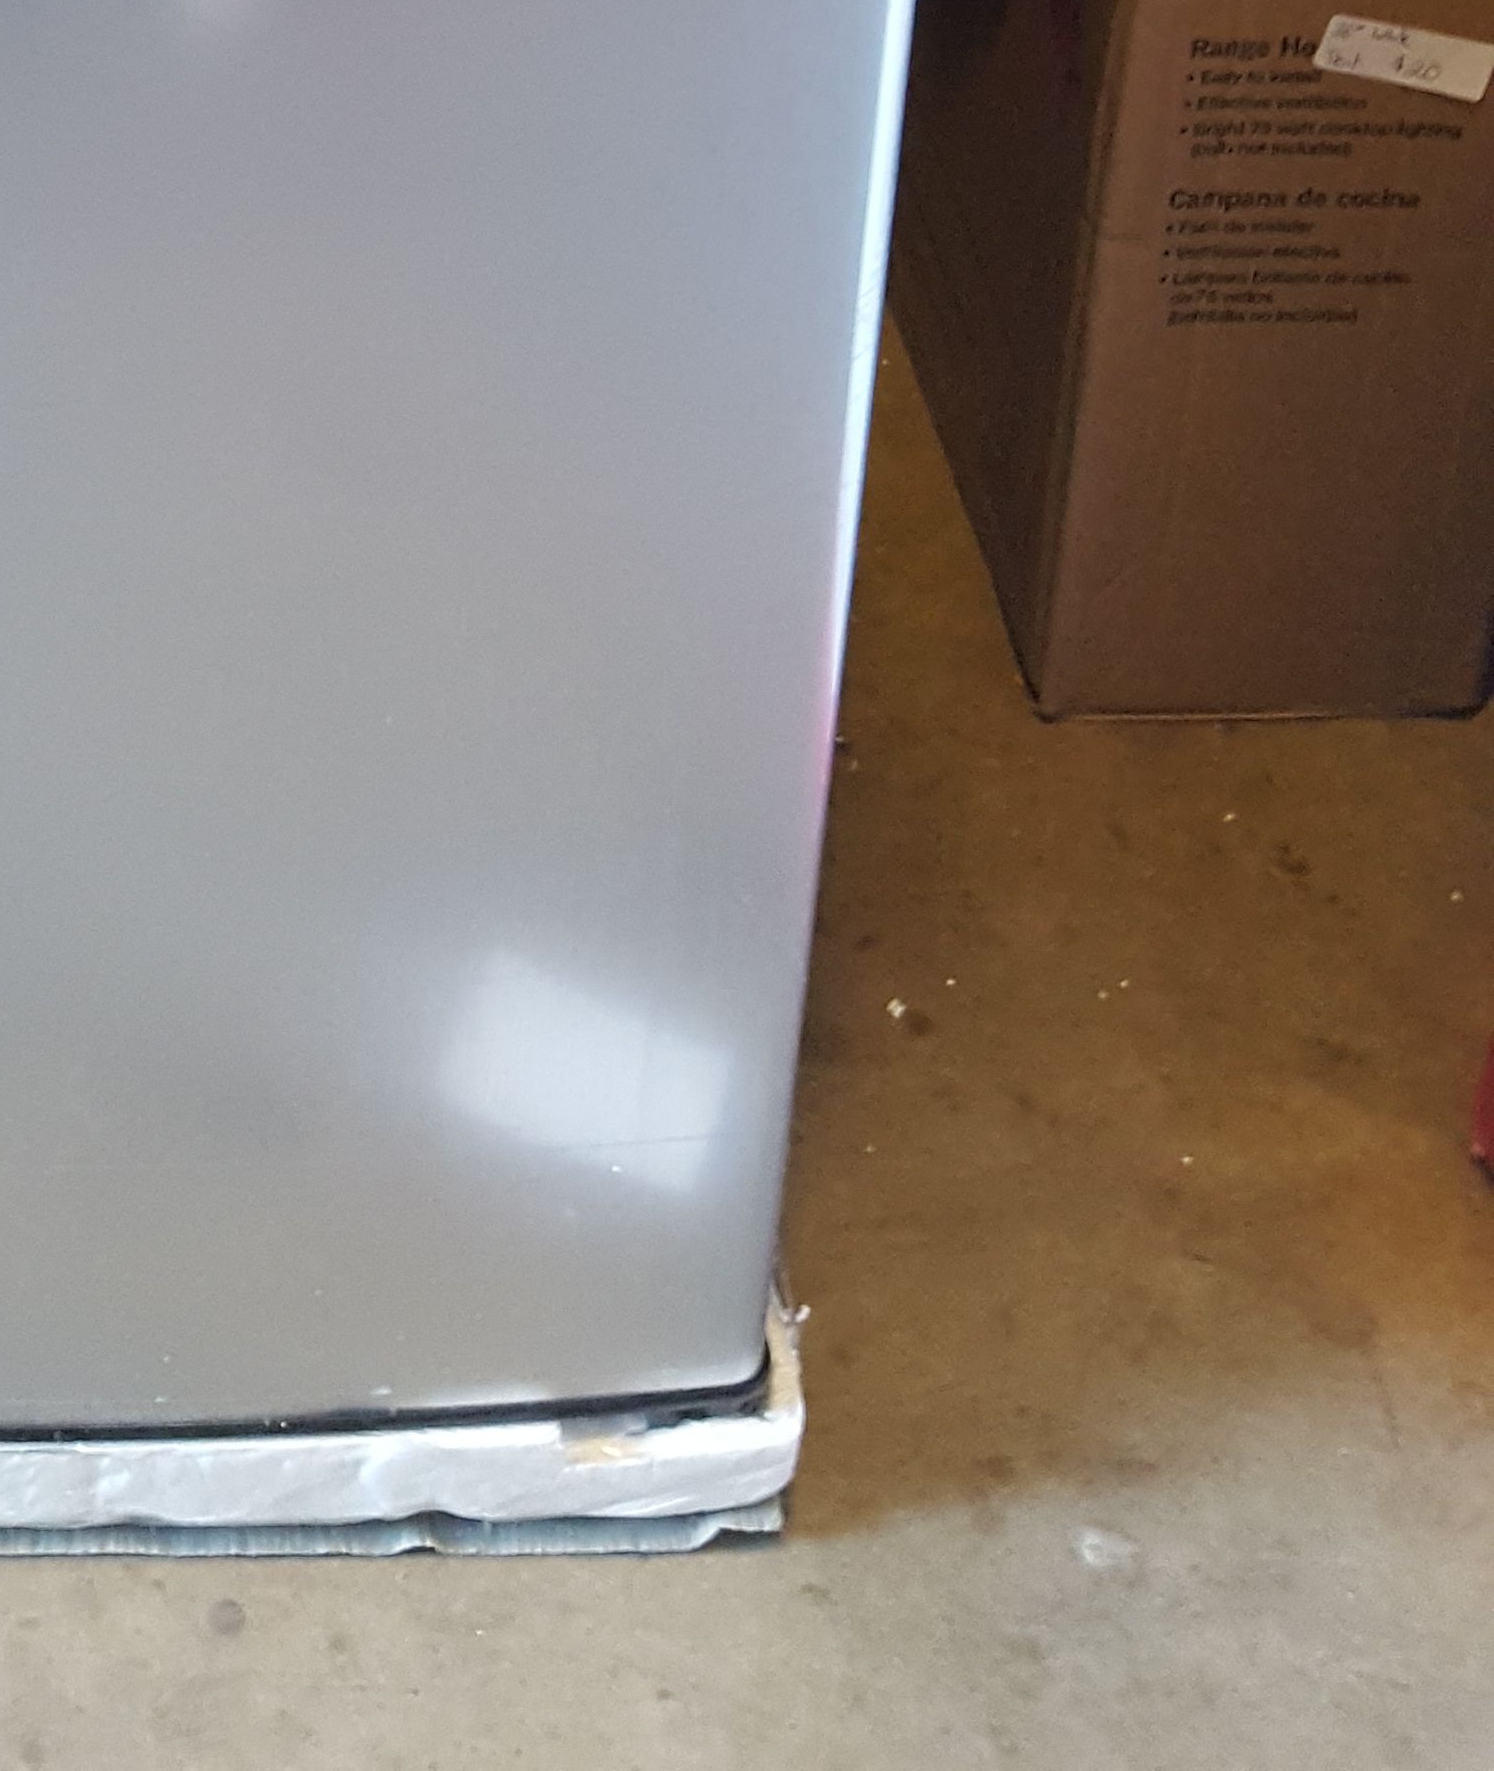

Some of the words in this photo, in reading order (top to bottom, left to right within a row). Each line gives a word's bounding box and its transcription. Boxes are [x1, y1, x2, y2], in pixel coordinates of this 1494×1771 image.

[1190, 38, 1271, 61] Range
[1279, 36, 1318, 57] Ho
[1168, 188, 1288, 213] Campana
[1295, 187, 1328, 208] de
